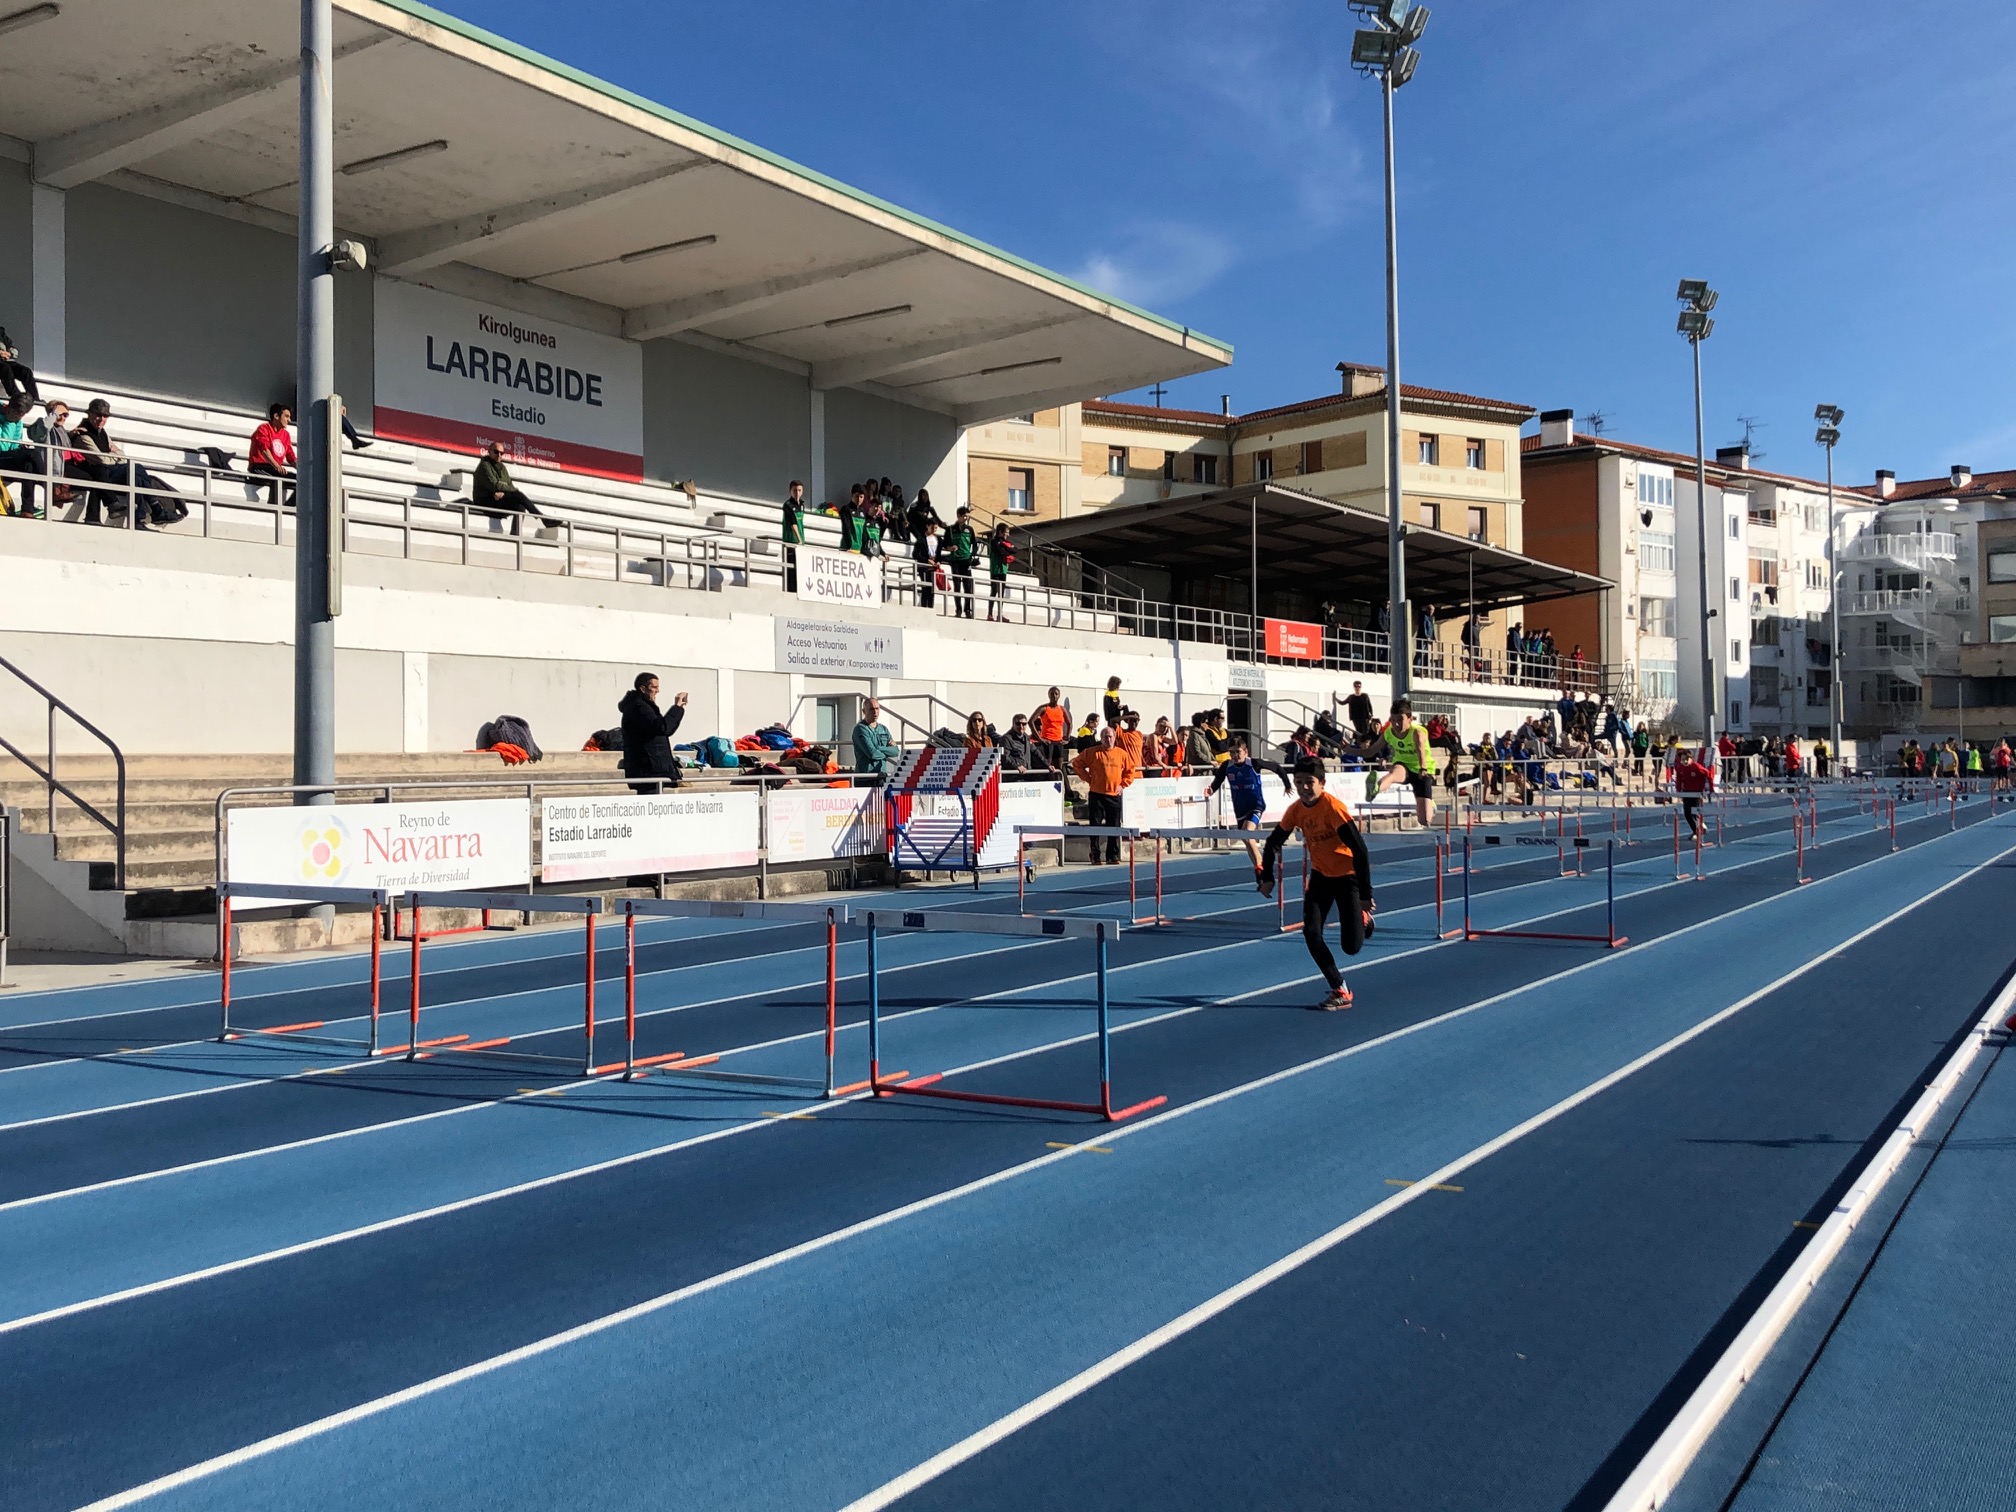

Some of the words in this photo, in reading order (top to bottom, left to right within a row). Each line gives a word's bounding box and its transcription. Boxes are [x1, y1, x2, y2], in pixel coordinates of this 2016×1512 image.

[479, 313, 556, 349] Kirolgunea
[426, 335, 603, 407] LARRABIDE
[491, 399, 546, 425] Estadio
[811, 554, 866, 579] IRTEERA
[816, 578, 863, 600] SALIDA
[786, 620, 833, 632] Aldageletarako
[833, 624, 859, 635] Sarbidea
[787, 635, 812, 647] Acceso
[813, 637, 848, 651] Vestuarios
[864, 642, 872, 653] WC
[787, 652, 810, 664] Salida
[811, 653, 819, 665] al
[880, 659, 898, 671] Irteera
[1000, 788, 1016, 799] eportiva
[548, 804, 576, 820] Centro
[579, 804, 589, 819] de
[592, 802, 645, 819] Tecnificación
[648, 801, 684, 818] Deportiva
[686, 801, 695, 815] de
[696, 801, 723, 814] Navarra
[400, 814, 435, 831] Reyno
[437, 812, 451, 826] de
[549, 825, 584, 842] Estadio
[587, 823, 632, 840] Larrabide
[363, 827, 482, 864] Navarra
[376, 874, 406, 888] Tierra
[409, 873, 420, 884] de
[421, 868, 470, 884] Diversidad
